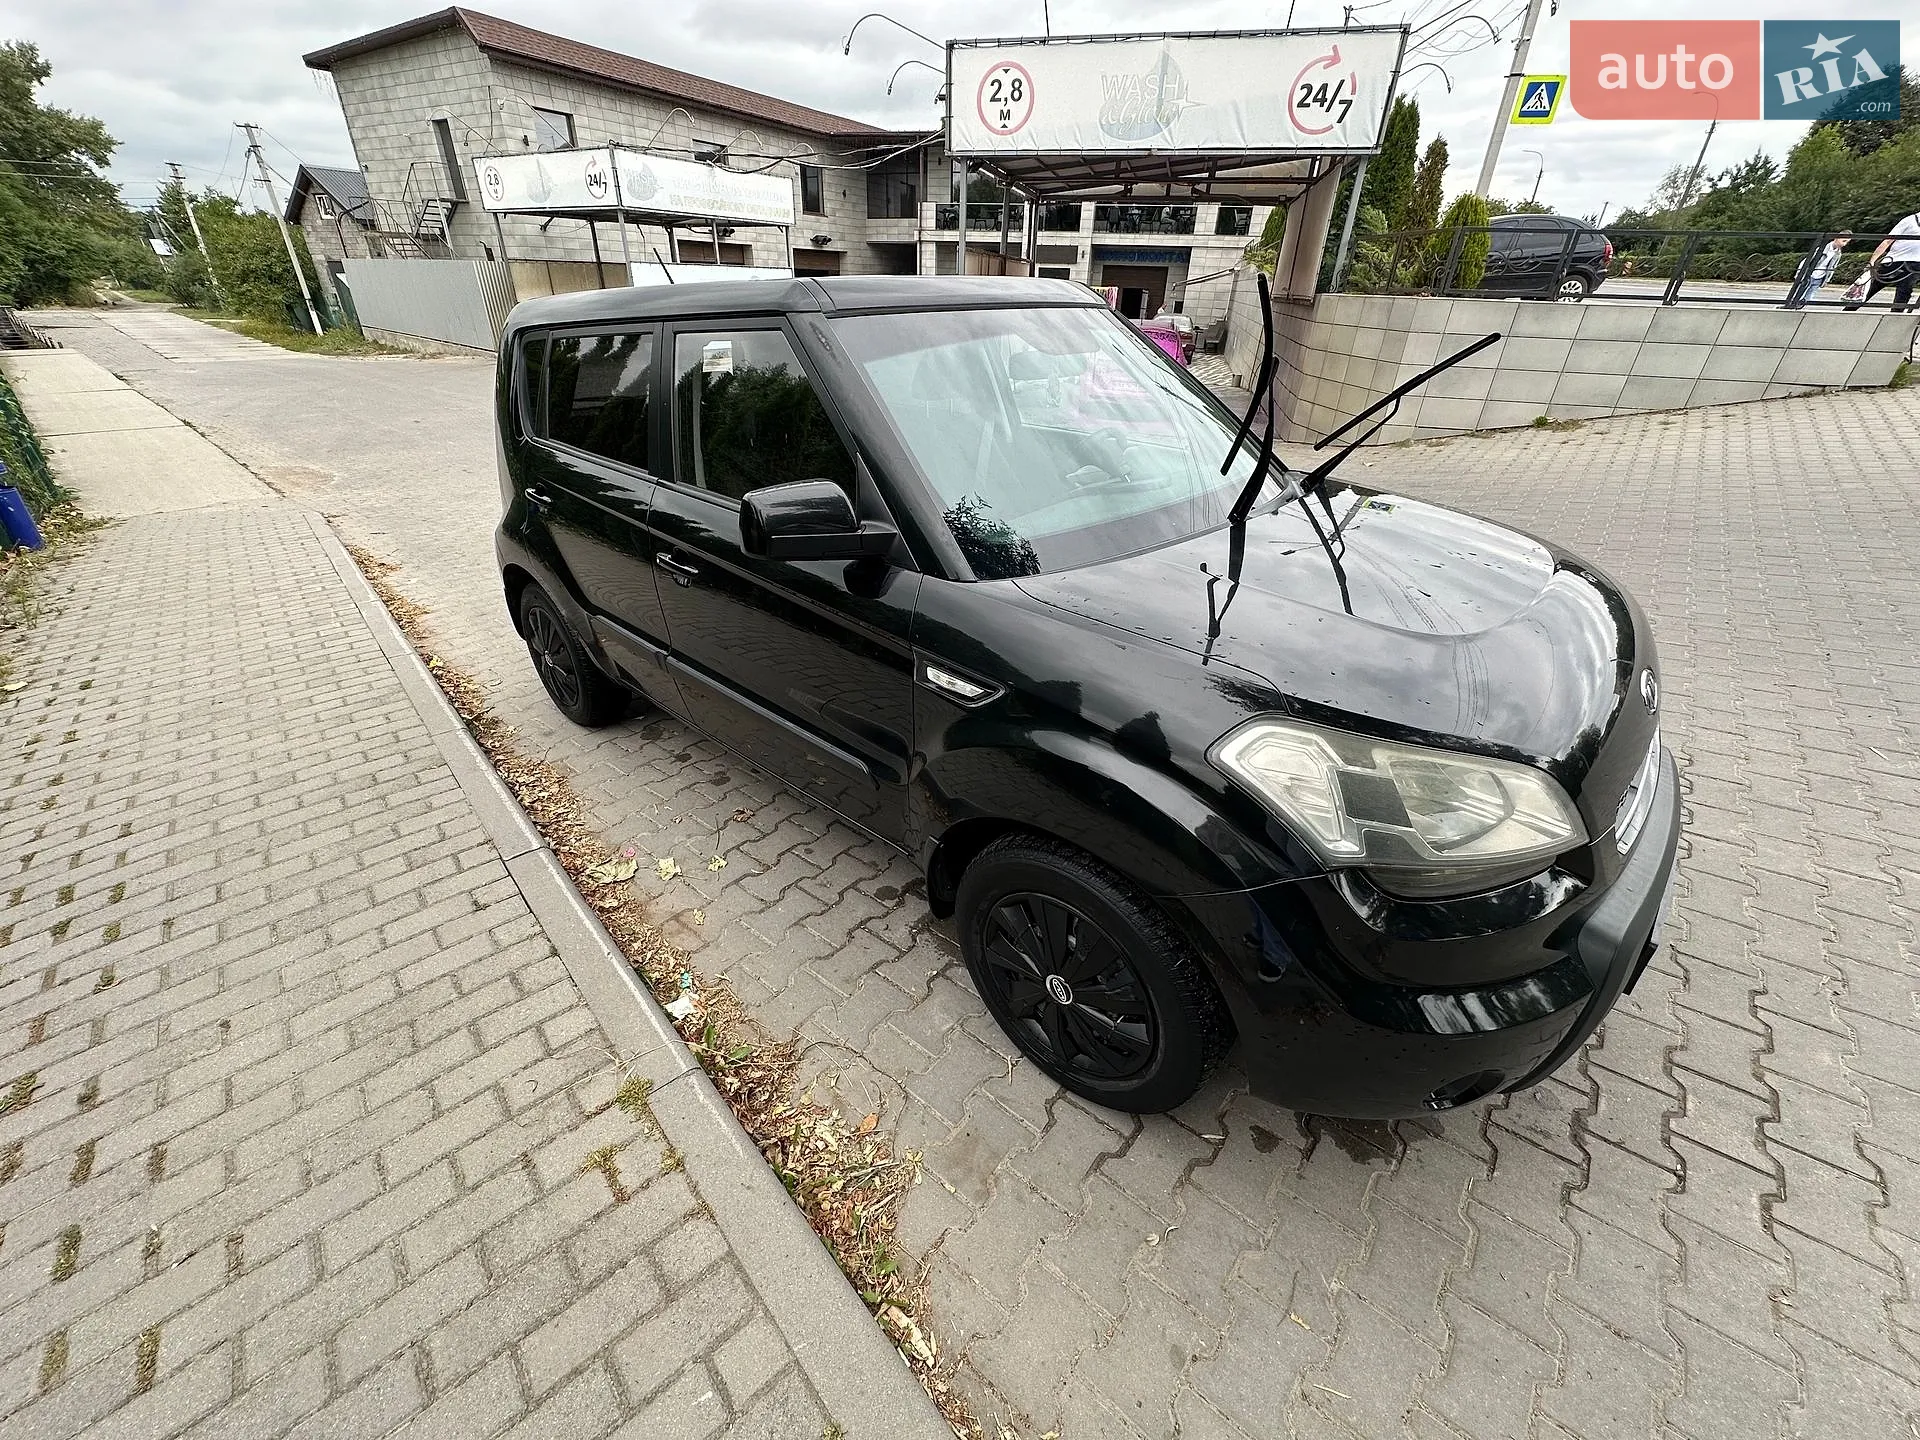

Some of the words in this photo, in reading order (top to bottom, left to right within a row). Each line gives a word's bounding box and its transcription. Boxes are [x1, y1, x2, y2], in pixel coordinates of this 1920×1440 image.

[989, 77, 1023, 107] 2,8
[1099, 73, 1180, 101] WASH
[1296, 78, 1353, 124] 24/7
[587, 171, 608, 194] 24/7
